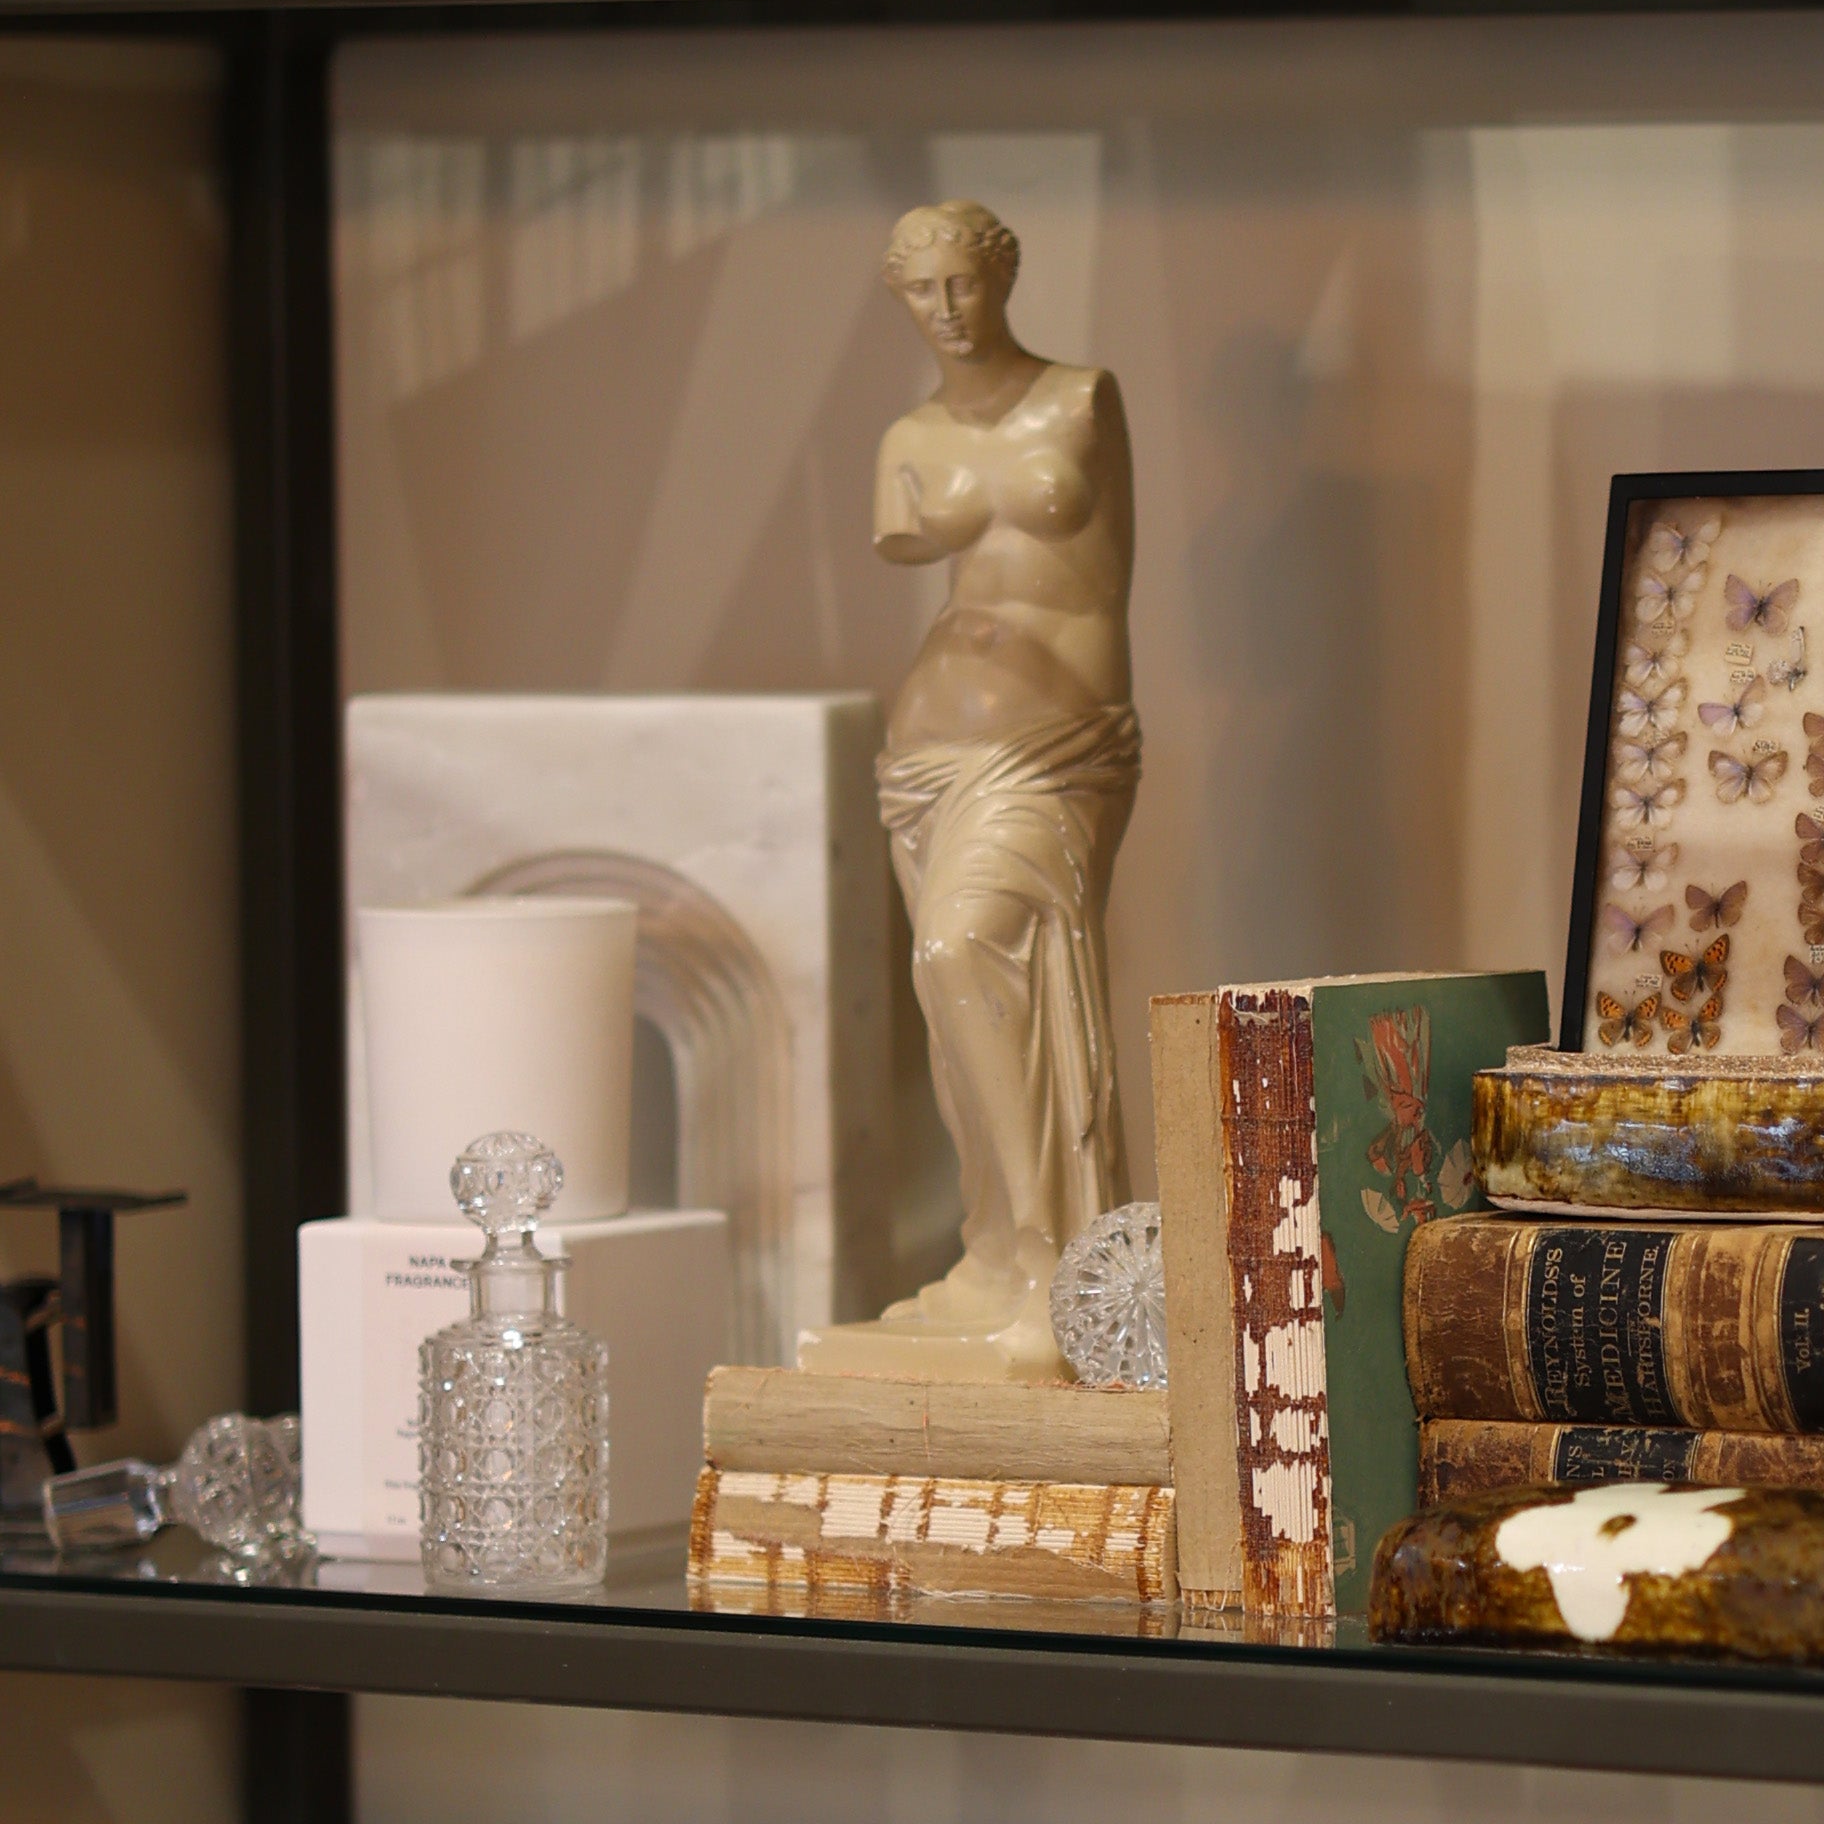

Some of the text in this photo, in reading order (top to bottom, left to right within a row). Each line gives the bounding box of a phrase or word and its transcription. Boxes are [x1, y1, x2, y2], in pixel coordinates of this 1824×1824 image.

[409, 1255, 446, 1268] NAPA
[1570, 1274, 1586, 1298] of
[1541, 1247, 1573, 1412] REYNOLDS'S
[1599, 1241, 1635, 1418] MEDICINE
[1794, 1308, 1810, 1328] II.
